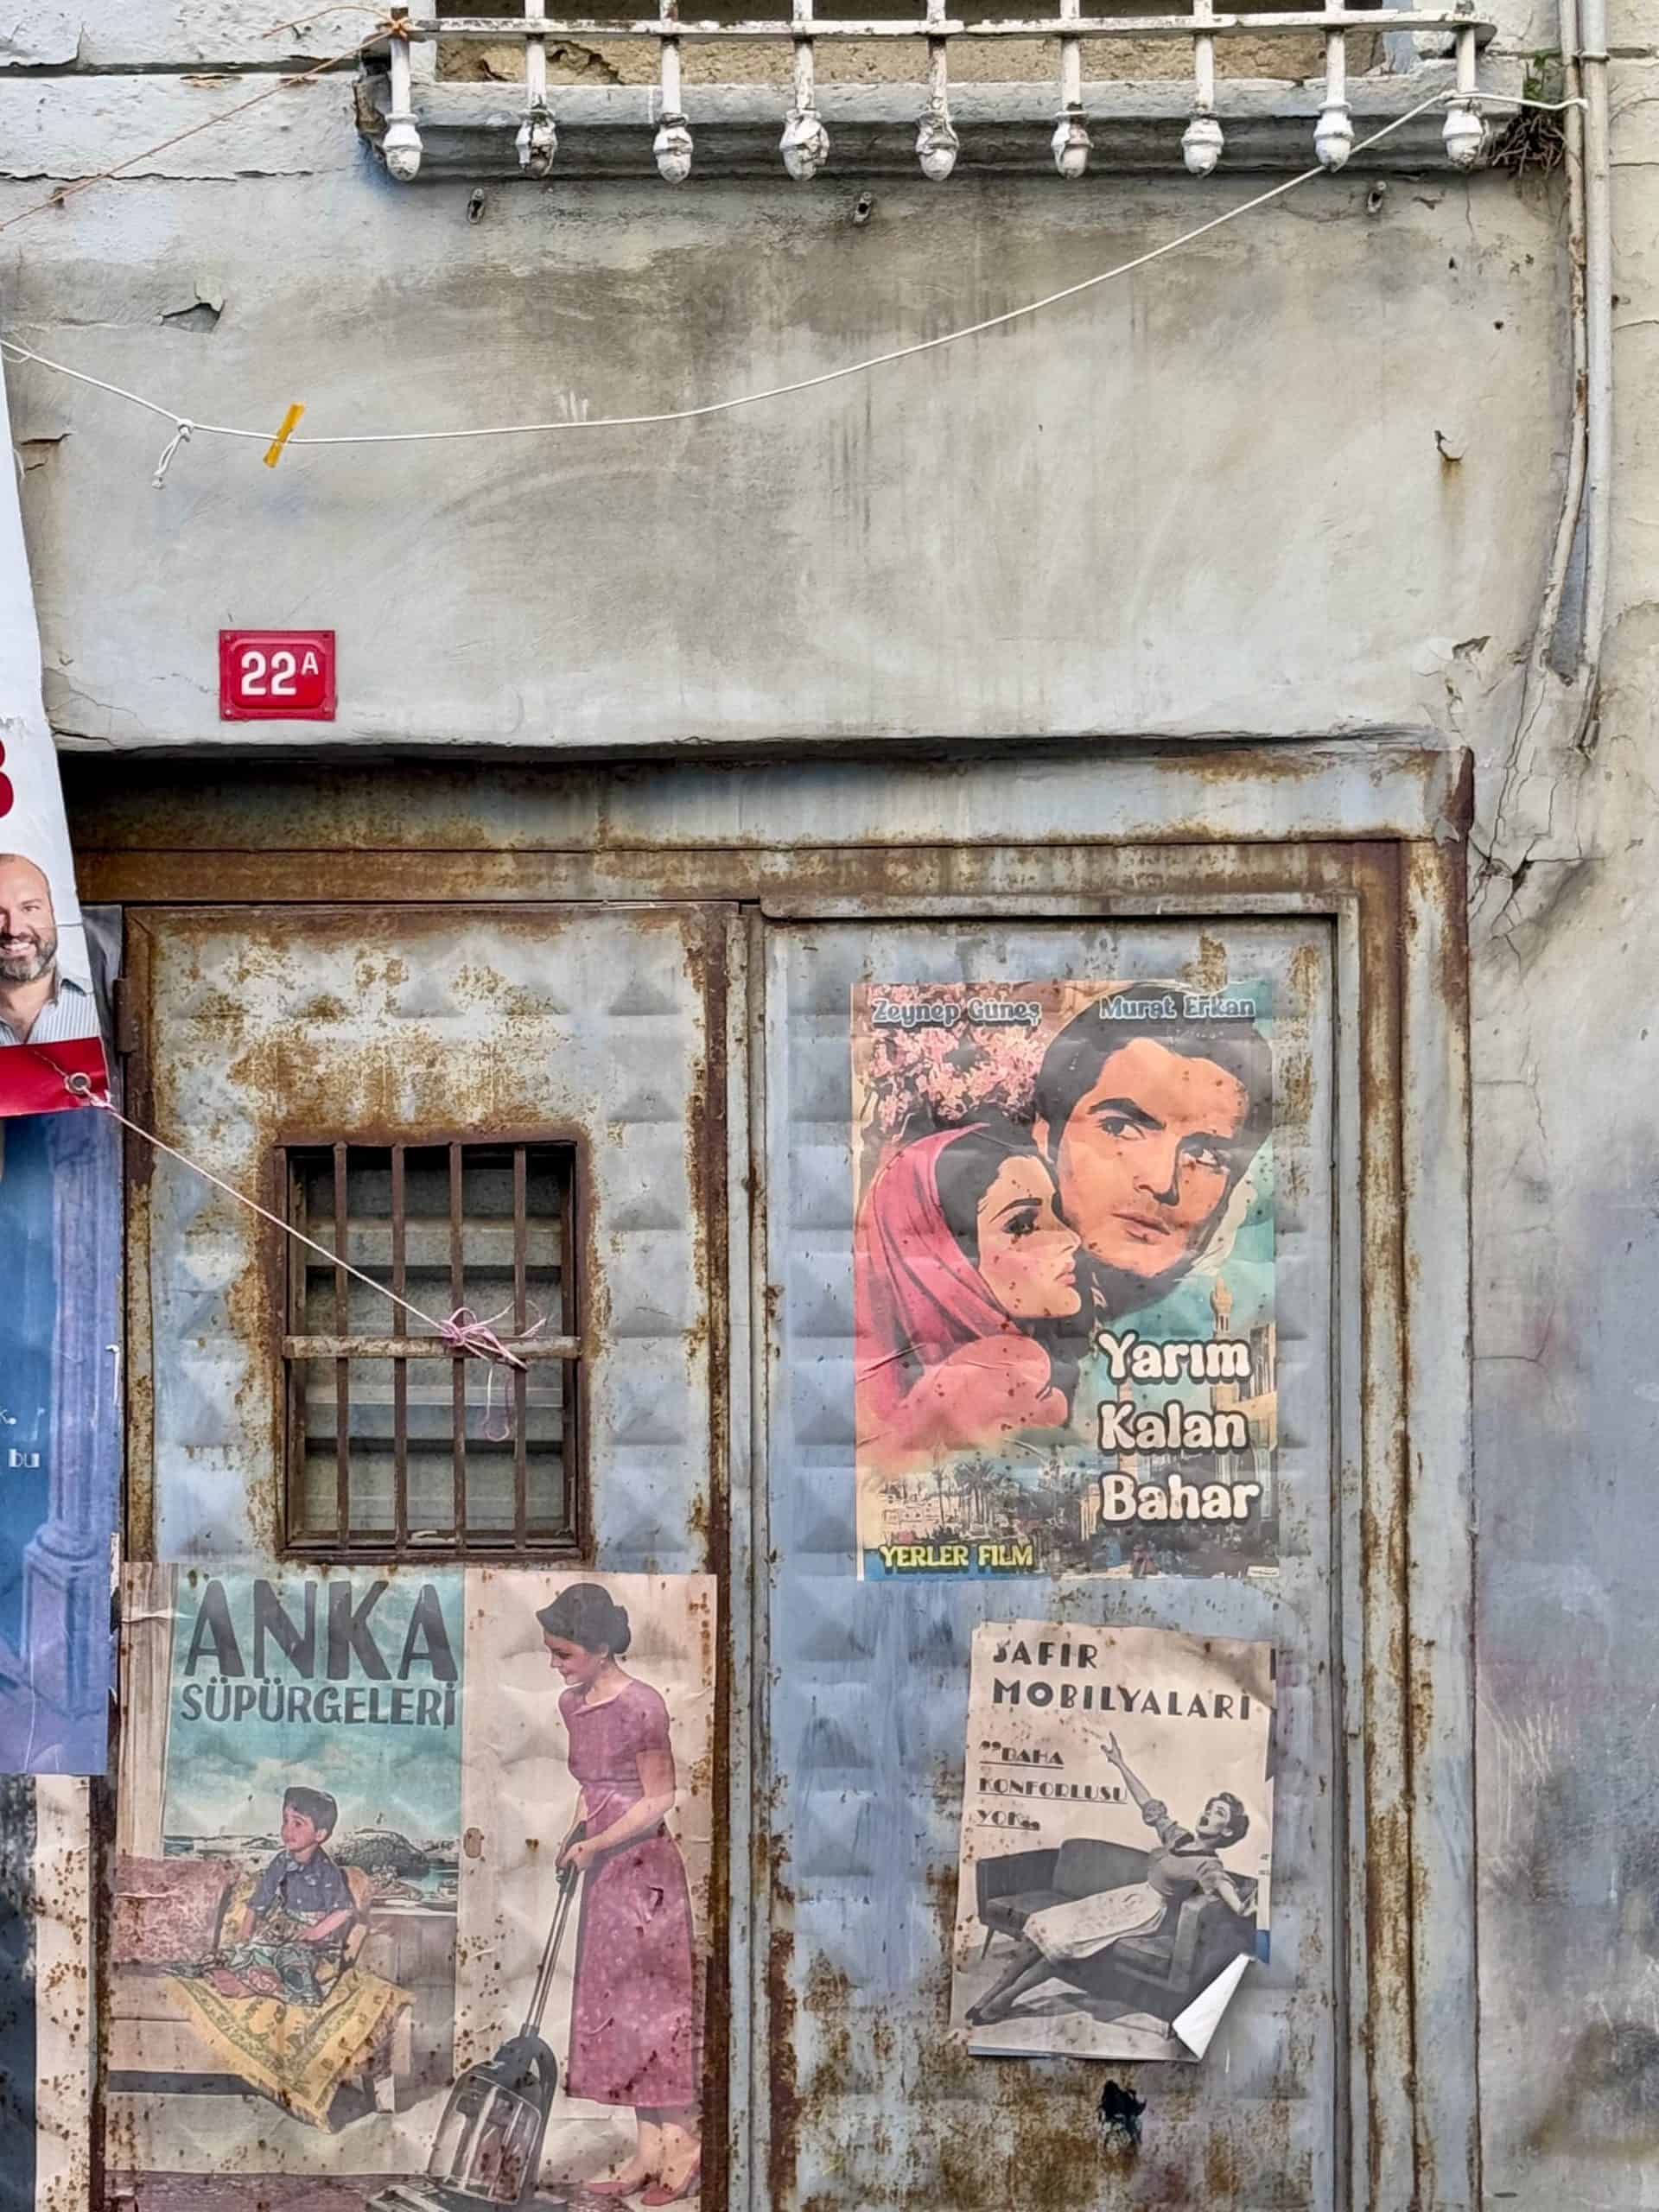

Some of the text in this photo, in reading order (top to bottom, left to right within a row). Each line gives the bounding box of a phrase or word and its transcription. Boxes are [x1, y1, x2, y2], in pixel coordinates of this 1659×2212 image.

[873, 997, 1042, 1027] Zeynep Güneş
[1099, 995, 1256, 1020] Murat Erkan
[1098, 1331, 1251, 1379] Yarım
[1099, 1402, 1249, 1451] Kalan
[8, 1448, 41, 1468] bu
[1100, 1472, 1262, 1522] Bahar
[880, 1544, 1033, 1567] YERLER FILM
[183, 1579, 459, 1681] ANKA
[180, 1676, 457, 1730] SÜPÜRGELERİ
